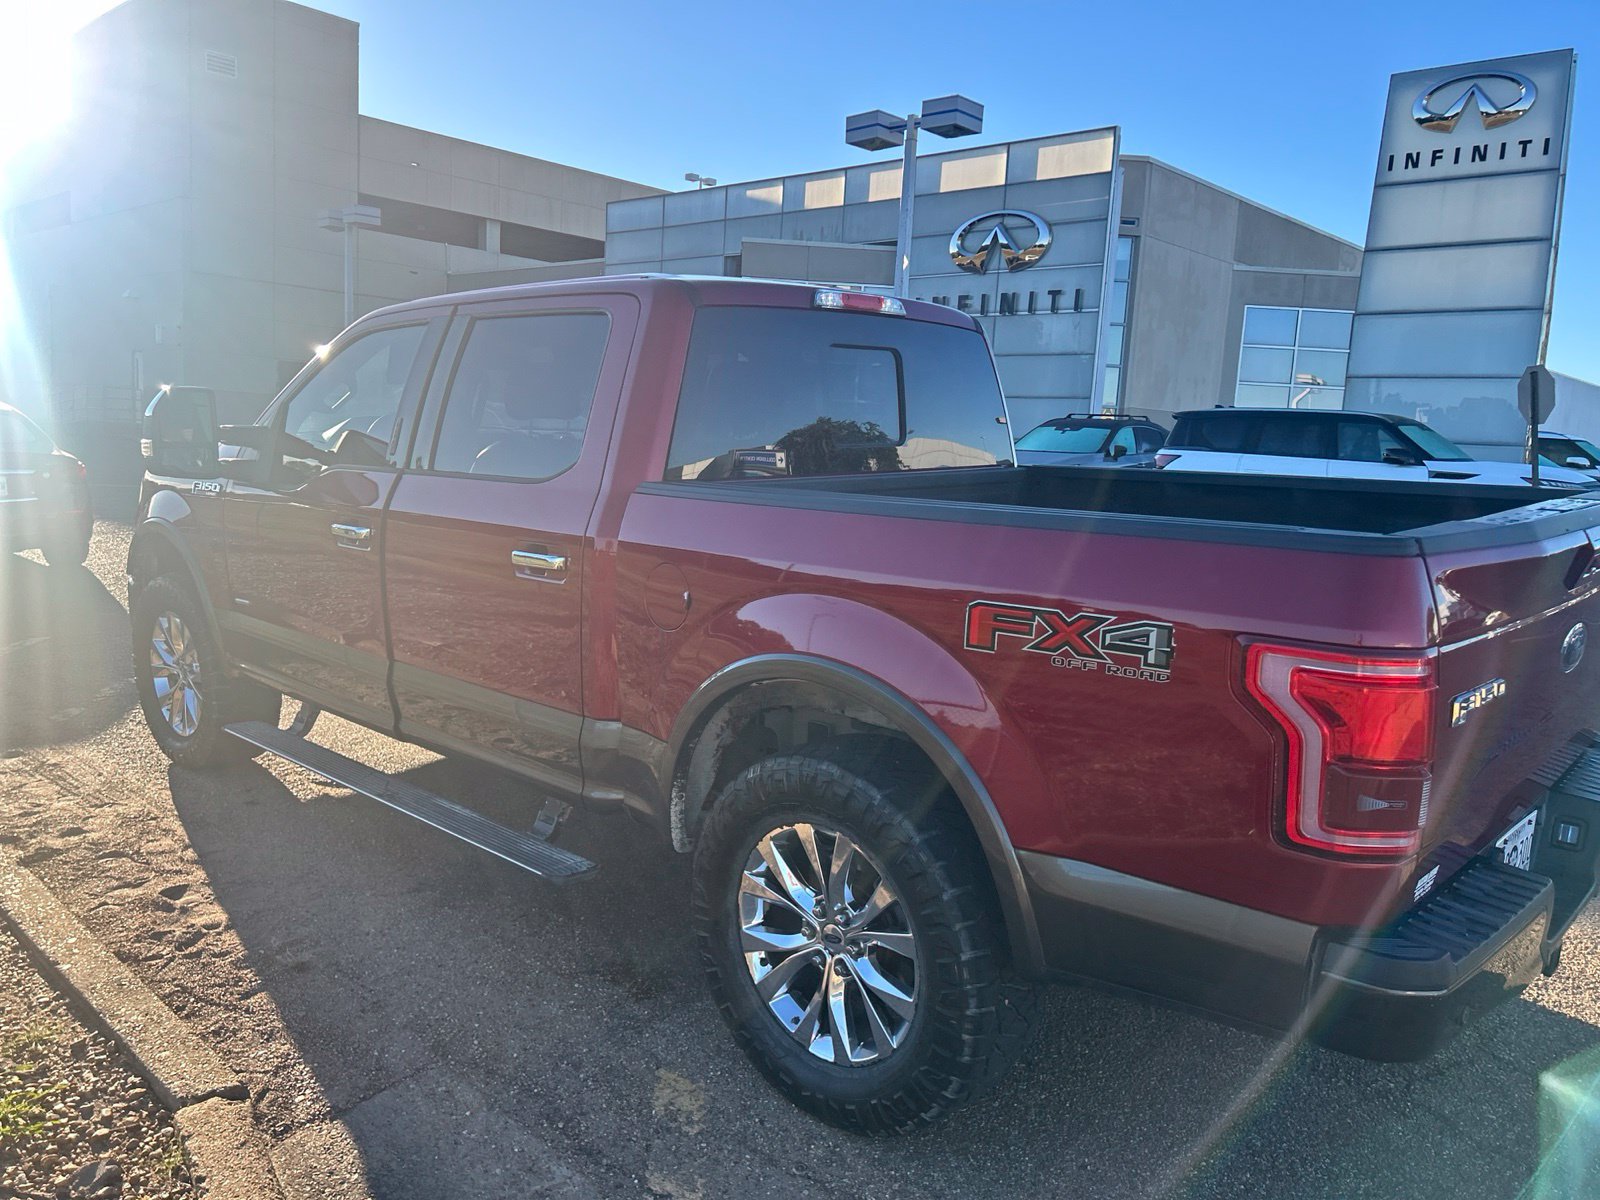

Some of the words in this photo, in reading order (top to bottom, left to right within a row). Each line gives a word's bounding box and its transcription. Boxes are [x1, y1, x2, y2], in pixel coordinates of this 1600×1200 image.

[1387, 137, 1551, 172] INFINITI
[915, 288, 1084, 317] FINITI
[964, 599, 1175, 672] FX4
[1051, 655, 1097, 671] OFF
[1105, 664, 1171, 683] ROAD
